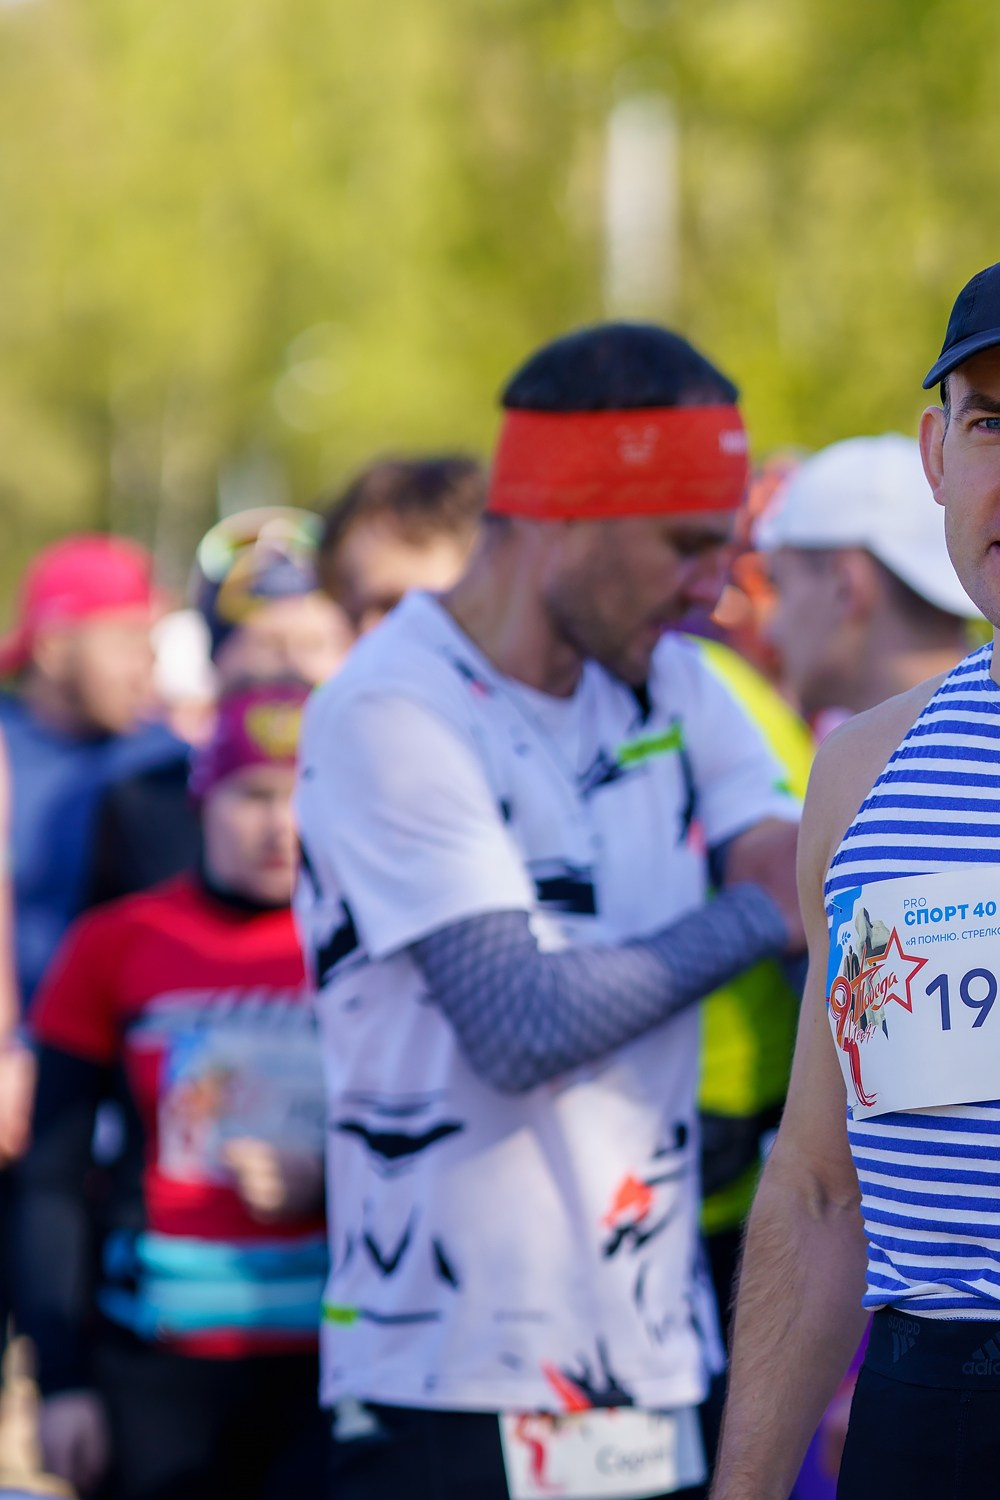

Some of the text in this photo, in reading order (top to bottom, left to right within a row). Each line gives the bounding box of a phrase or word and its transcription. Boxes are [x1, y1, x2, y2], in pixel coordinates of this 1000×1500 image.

[903, 897, 927, 910] PRO
[904, 901, 997, 926] СПОРТ 40
[905, 937, 917, 946] «Я
[918, 932, 960, 945] ПОМНЮ.
